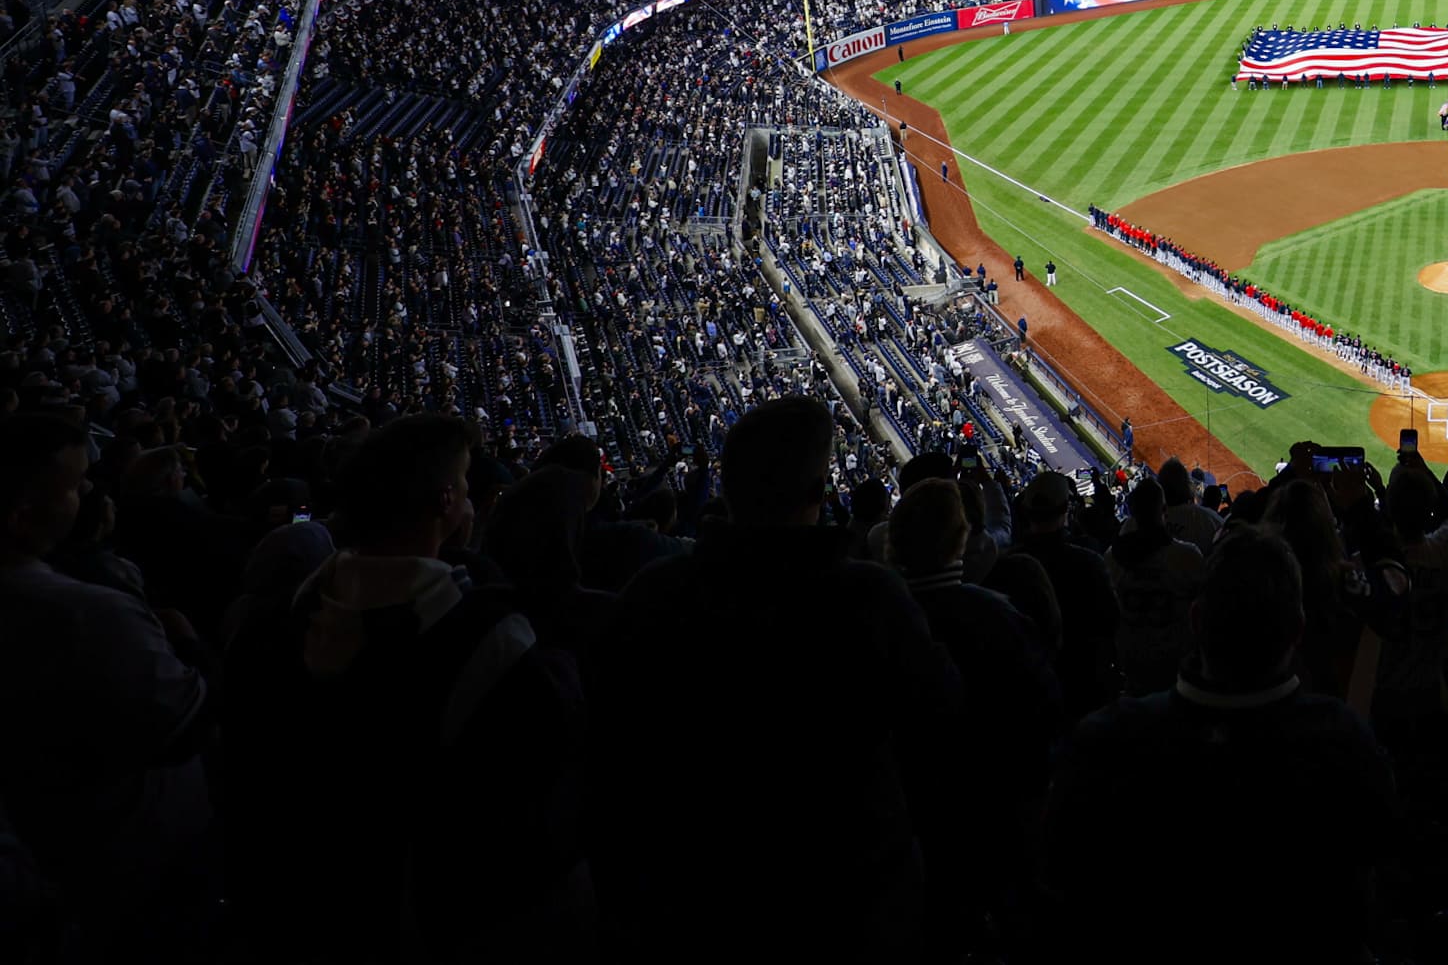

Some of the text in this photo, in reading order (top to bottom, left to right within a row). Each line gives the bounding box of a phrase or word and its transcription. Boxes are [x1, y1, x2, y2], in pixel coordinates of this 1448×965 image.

[890, 16, 951, 35] Montefiore Einstein
[829, 32, 883, 63] Canon
[1174, 341, 1279, 405] POSTSEASON
[1003, 402, 1036, 427] Yankee
[1030, 426, 1058, 453] Stadium
